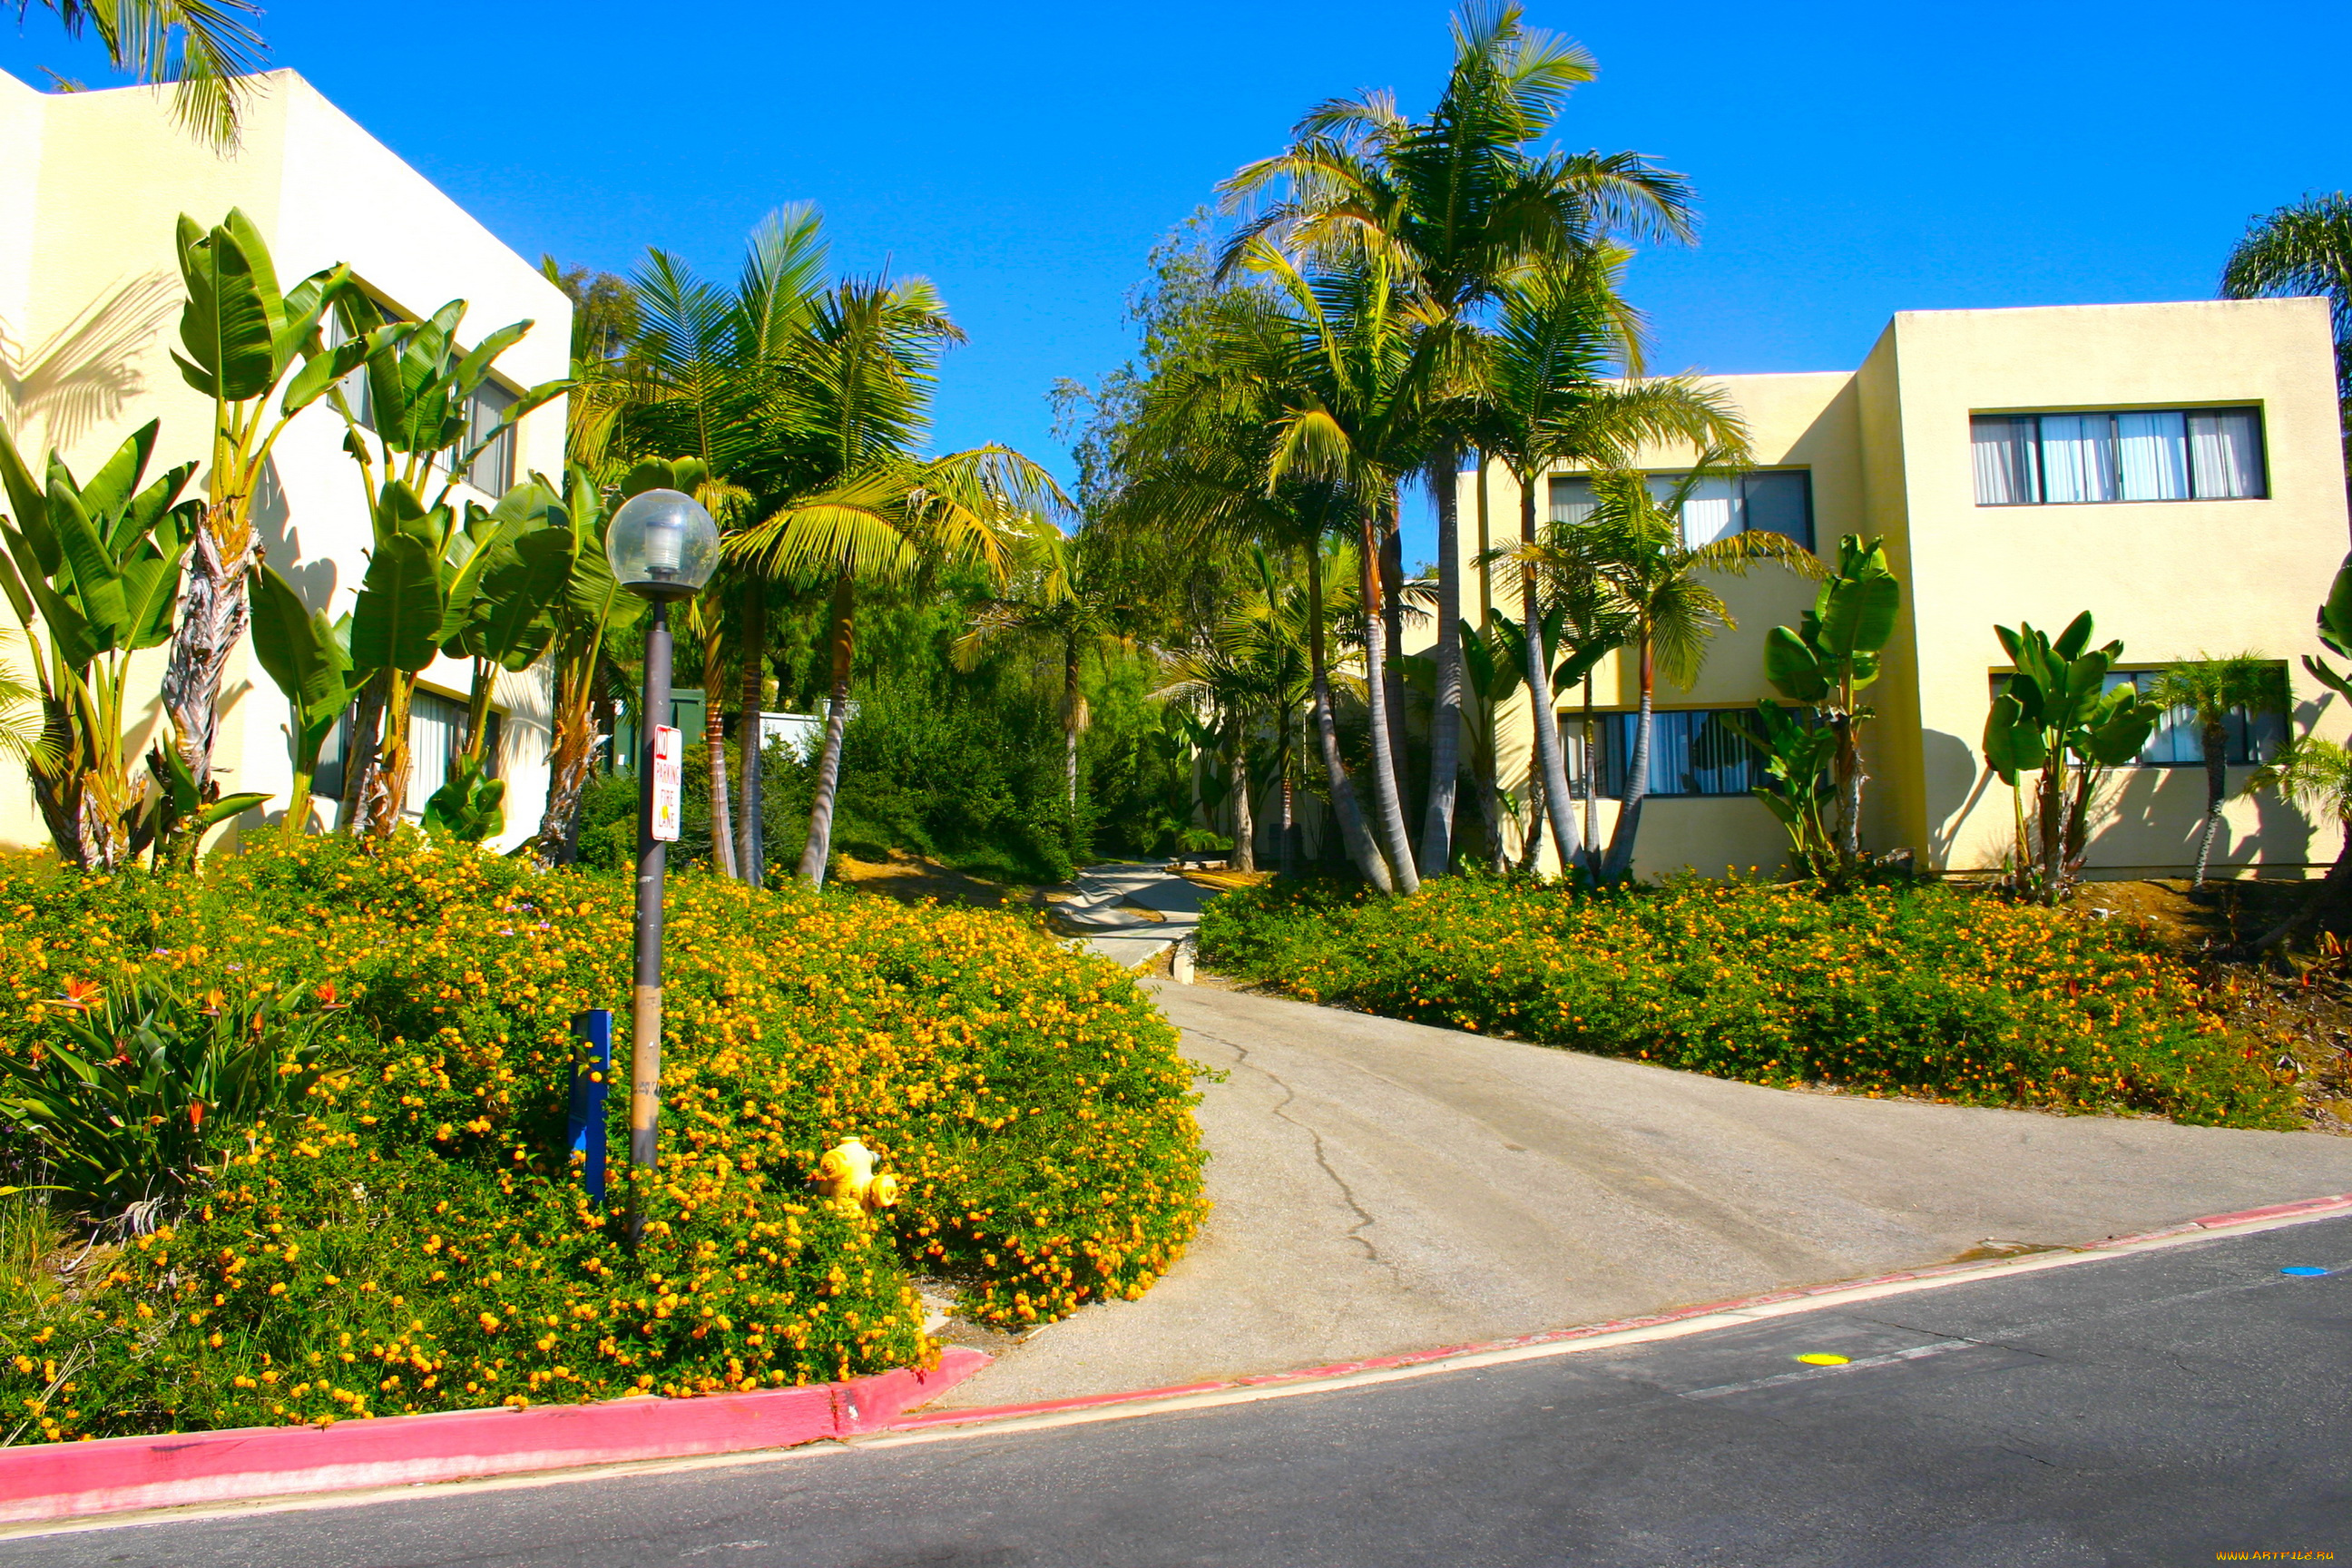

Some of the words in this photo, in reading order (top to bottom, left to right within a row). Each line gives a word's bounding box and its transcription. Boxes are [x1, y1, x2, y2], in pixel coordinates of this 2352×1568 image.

[656, 730, 667, 756] NO
[656, 761, 679, 786] PARKING
[661, 789, 673, 807] FIRE
